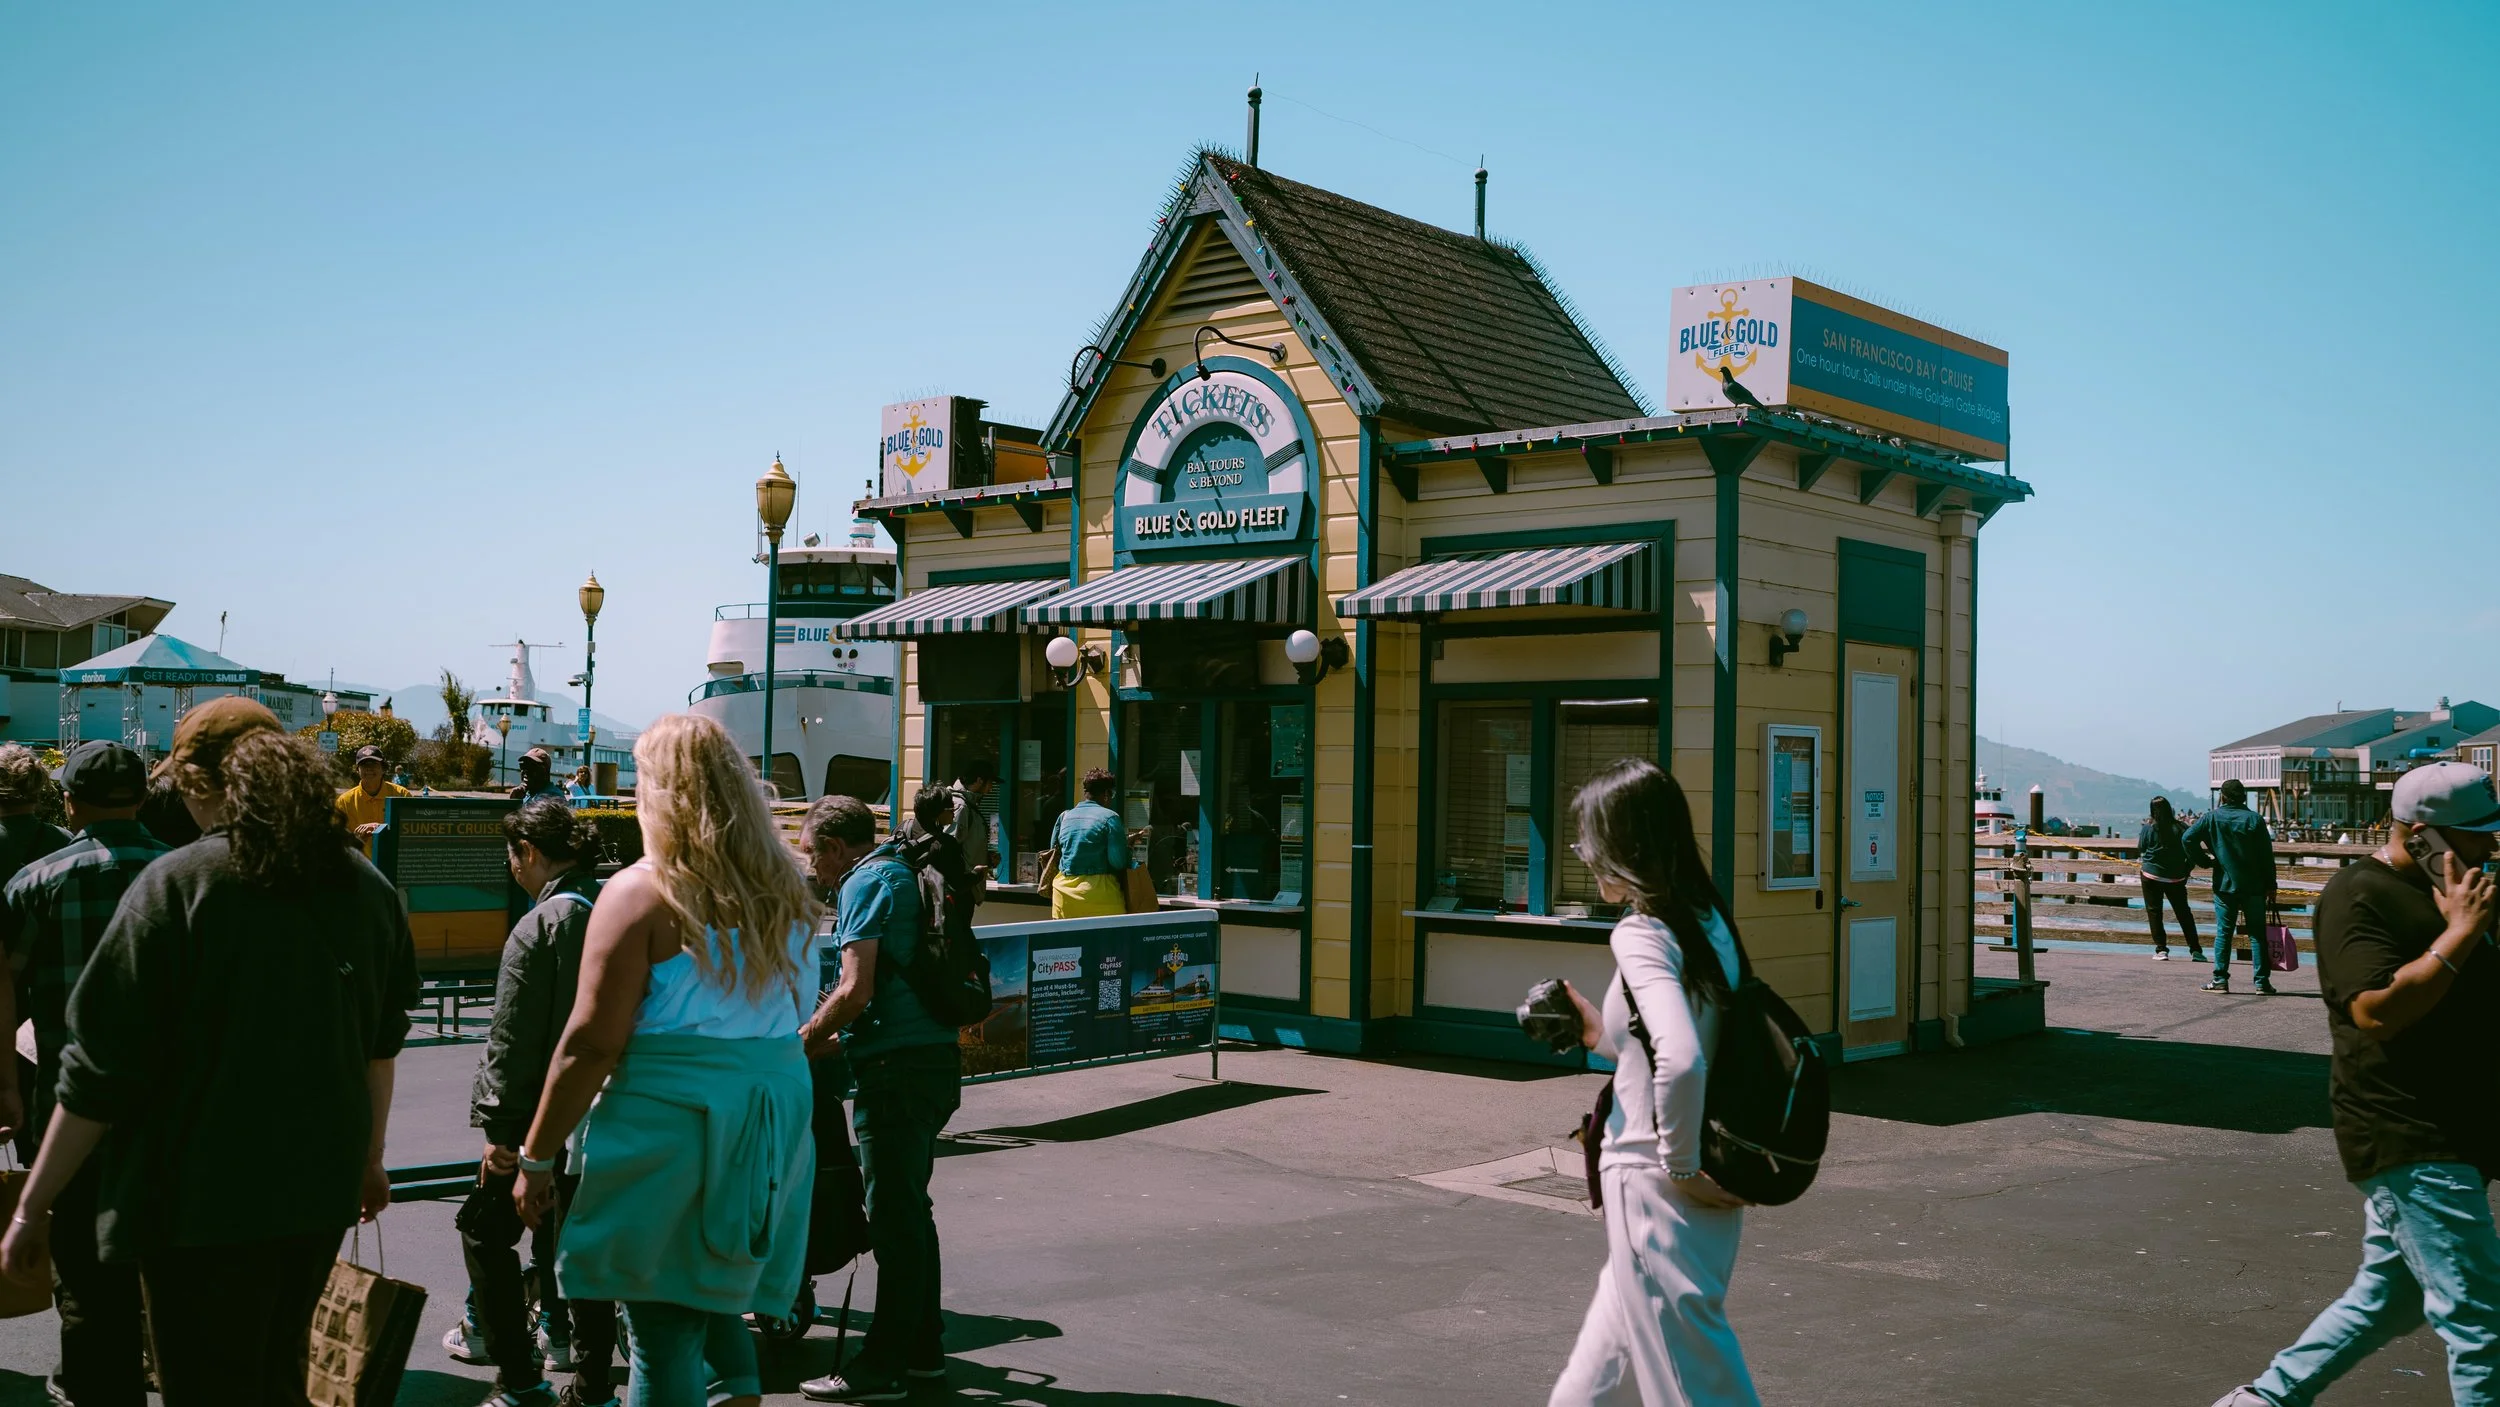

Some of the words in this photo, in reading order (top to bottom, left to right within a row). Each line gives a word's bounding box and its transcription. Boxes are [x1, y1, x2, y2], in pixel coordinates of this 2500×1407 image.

[1680, 320, 1720, 353] BLUE
[1721, 321, 1734, 340] &
[1736, 318, 1778, 347] GOLD
[1713, 343, 1740, 357] FLEET
[1823, 328, 1847, 352] SAN
[1850, 337, 1914, 373] FRANCISCO
[1917, 360, 1936, 380] BAY
[1940, 368, 1974, 392] CRUISE
[1796, 348, 1816, 366] One
[1819, 352, 1840, 374] hour
[1842, 364, 1861, 381] tour.
[1863, 368, 1881, 387] Sails
[1882, 376, 1907, 395] under
[1909, 383, 1922, 399] the
[1924, 387, 1954, 408] Golden
[1956, 397, 1975, 415] Gate
[1977, 403, 2003, 425] Bridge.
[1152, 384, 1269, 438] TICKETS
[887, 430, 910, 455] BLUE
[919, 427, 943, 448] GOLD
[1187, 460, 1207, 474] BAY
[1210, 457, 1245, 470] TOURS
[1188, 477, 1198, 489] &
[1200, 473, 1242, 488] BEYOND
[1135, 514, 1171, 535] BLUE
[1175, 508, 1193, 532] &
[1197, 510, 1237, 531] GOLD
[1241, 505, 1286, 527] FLEET
[797, 628, 830, 642] BLUE
[143, 670, 164, 680] GET
[166, 672, 198, 682] READY
[200, 673, 214, 682] TO
[215, 673, 247, 683] SMILE!
[266, 696, 293, 710] MARINE
[402, 822, 452, 835] SUNSET
[457, 822, 501, 835] CRUISE
[1049, 953, 1077, 961] FRANCISCO
[1037, 960, 1077, 975] CityPASS
[1103, 969, 1117, 977] HERE
[1032, 984, 1044, 992] Save
